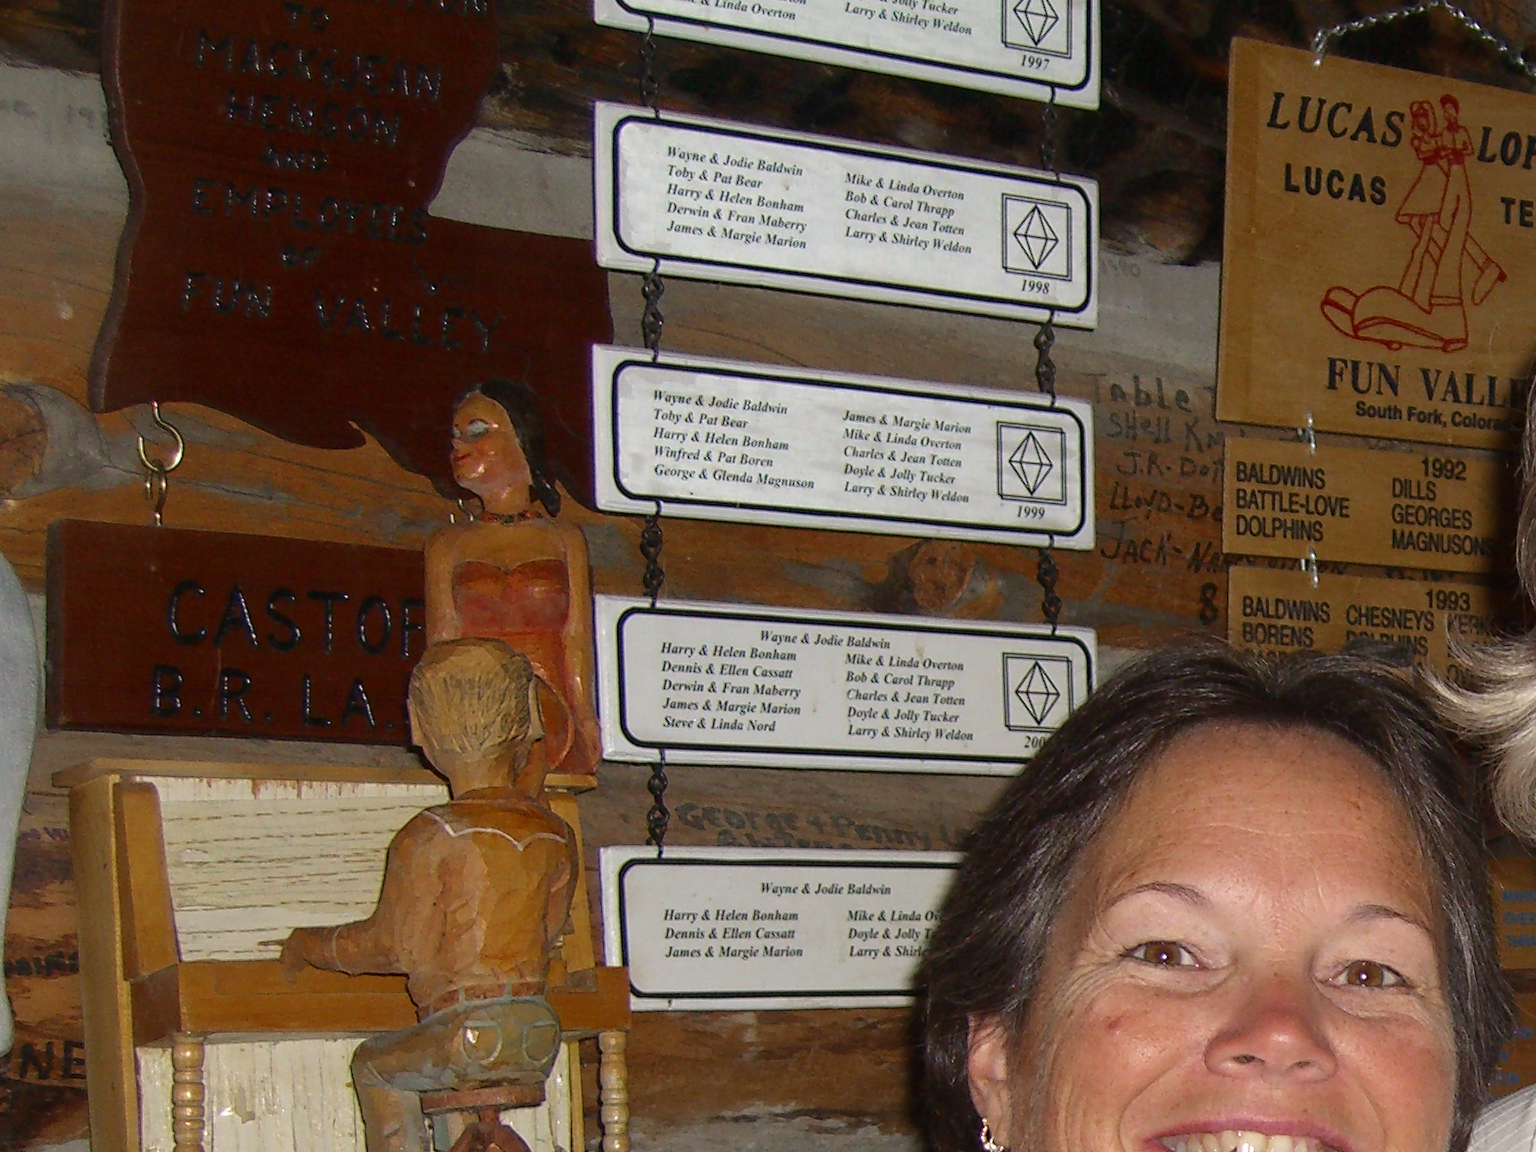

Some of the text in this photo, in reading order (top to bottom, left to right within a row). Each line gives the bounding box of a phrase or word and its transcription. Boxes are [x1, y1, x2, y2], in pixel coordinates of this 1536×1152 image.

[751, 2, 797, 21] Overton
[844, 1, 973, 36] Larry & Shirley Weldon
[1020, 53, 1051, 71] 1997
[226, 87, 400, 146] HENSON
[1267, 91, 1405, 147] LUCAS
[262, 143, 330, 173] AND
[667, 145, 804, 177] Wayne & Jodie Baldwin
[667, 163, 764, 189] Toby & Pat Bear
[844, 171, 965, 201] Mike & Linda Overton
[1284, 162, 1387, 206] LUCAS
[666, 182, 805, 213] Harry & Helen Bonham
[844, 189, 956, 220] Bob & Carol Thrapp
[195, 176, 428, 247] EMPLOYEES
[666, 201, 710, 219] Derwin
[712, 207, 723, 221] &
[727, 209, 756, 225] Fran
[844, 207, 888, 225] Charles
[889, 214, 900, 227] &
[901, 216, 929, 231] Jean
[666, 219, 807, 250] James & Margie Marion
[844, 225, 973, 255] Larry & Shirley Weldon
[1020, 278, 1051, 296] 1998
[184, 271, 505, 353] FUN VALLEY
[1327, 357, 1527, 411] FUN VALLE
[1355, 400, 1403, 421] South
[1407, 405, 1448, 429] Fork,
[654, 444, 774, 468] Winfred & Pat Boren
[1422, 456, 1468, 482] 1992
[653, 463, 815, 490] George & Glenda Magnuson
[843, 462, 957, 485] Doyle & Jolly Tucker
[1236, 460, 1326, 490] BALDWINS
[1391, 477, 1437, 502] DILLS
[1016, 504, 1046, 521] 1999
[1236, 488, 1350, 519] BATTLE-LOVE
[1391, 503, 1473, 531] GEORGES
[1236, 514, 1324, 542] DOLPHINS
[1241, 595, 1331, 624] BALDWINS
[1345, 604, 1435, 632] CHESNEYS
[1424, 588, 1471, 613] 1993
[1241, 622, 1314, 648] BORENS
[660, 659, 703, 675] Dennis
[704, 662, 716, 676] &
[718, 663, 750, 677] Ellen
[662, 715, 777, 733] Steve & Linda Nord
[1023, 735, 1046, 749] 200
[663, 908, 799, 925] Harry & Helen Bonham
[664, 944, 804, 961] James & Margie Marion
[848, 944, 929, 961] Larry & Shirle
